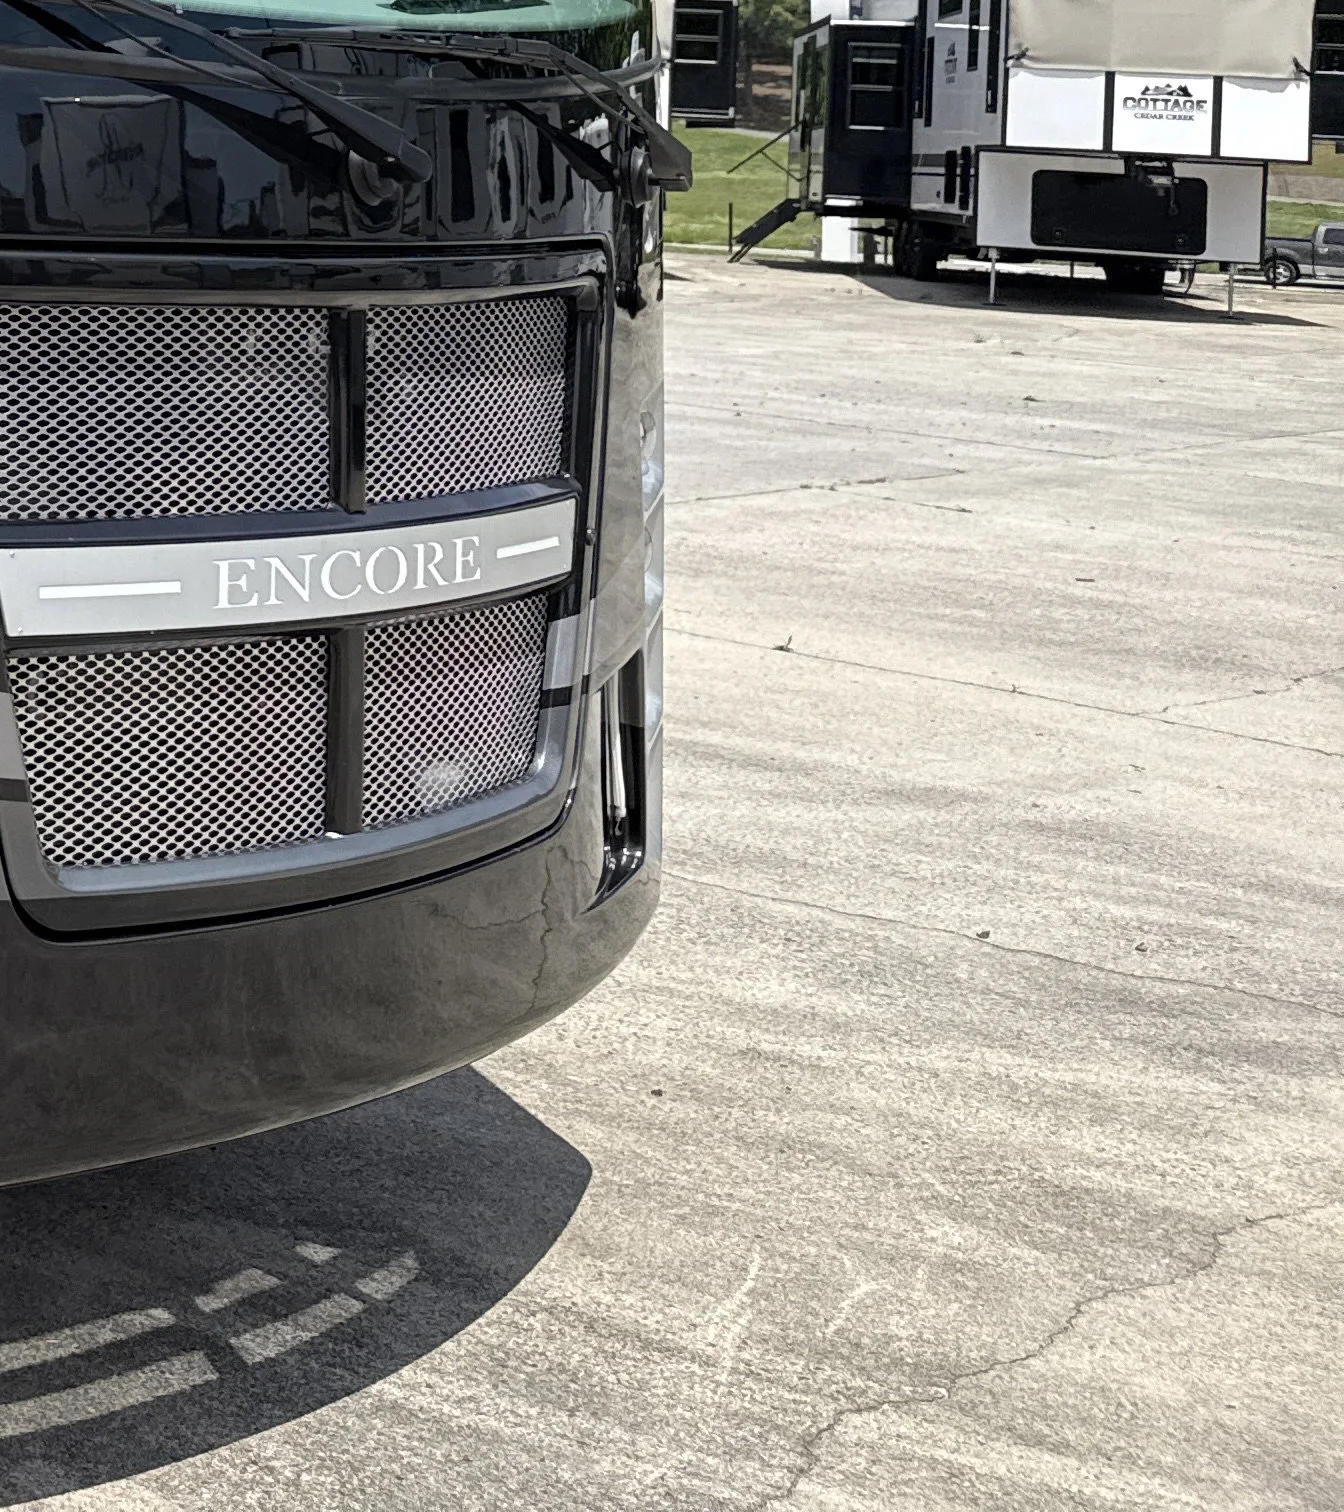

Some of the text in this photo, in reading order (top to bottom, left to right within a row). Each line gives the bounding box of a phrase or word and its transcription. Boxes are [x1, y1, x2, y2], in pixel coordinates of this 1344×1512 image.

[1123, 96, 1208, 113] COTTAGE
[1134, 112, 1195, 121] CEDAR CREEK
[212, 535, 481, 610] ENCORE
